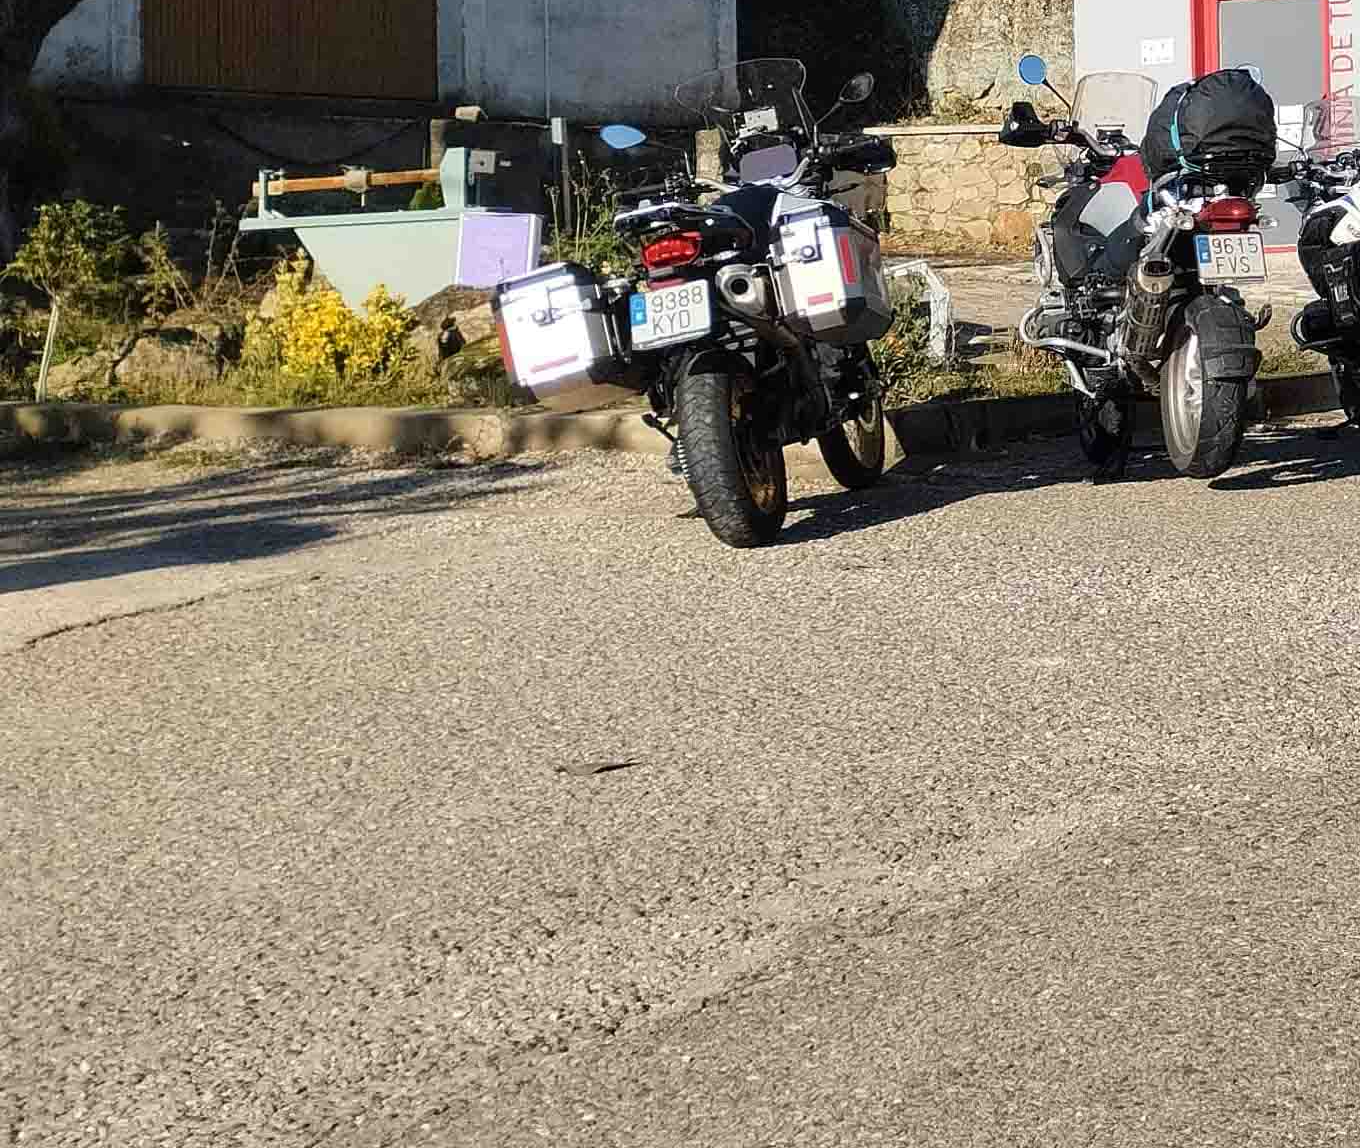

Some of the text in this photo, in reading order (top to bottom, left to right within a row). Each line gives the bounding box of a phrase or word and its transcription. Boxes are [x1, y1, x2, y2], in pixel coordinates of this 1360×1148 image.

[1330, 33, 1354, 73] DE
[1211, 236, 1258, 254] 9615
[1215, 256, 1250, 274] FVS
[651, 285, 703, 313] 9388
[652, 309, 690, 335] KYD
